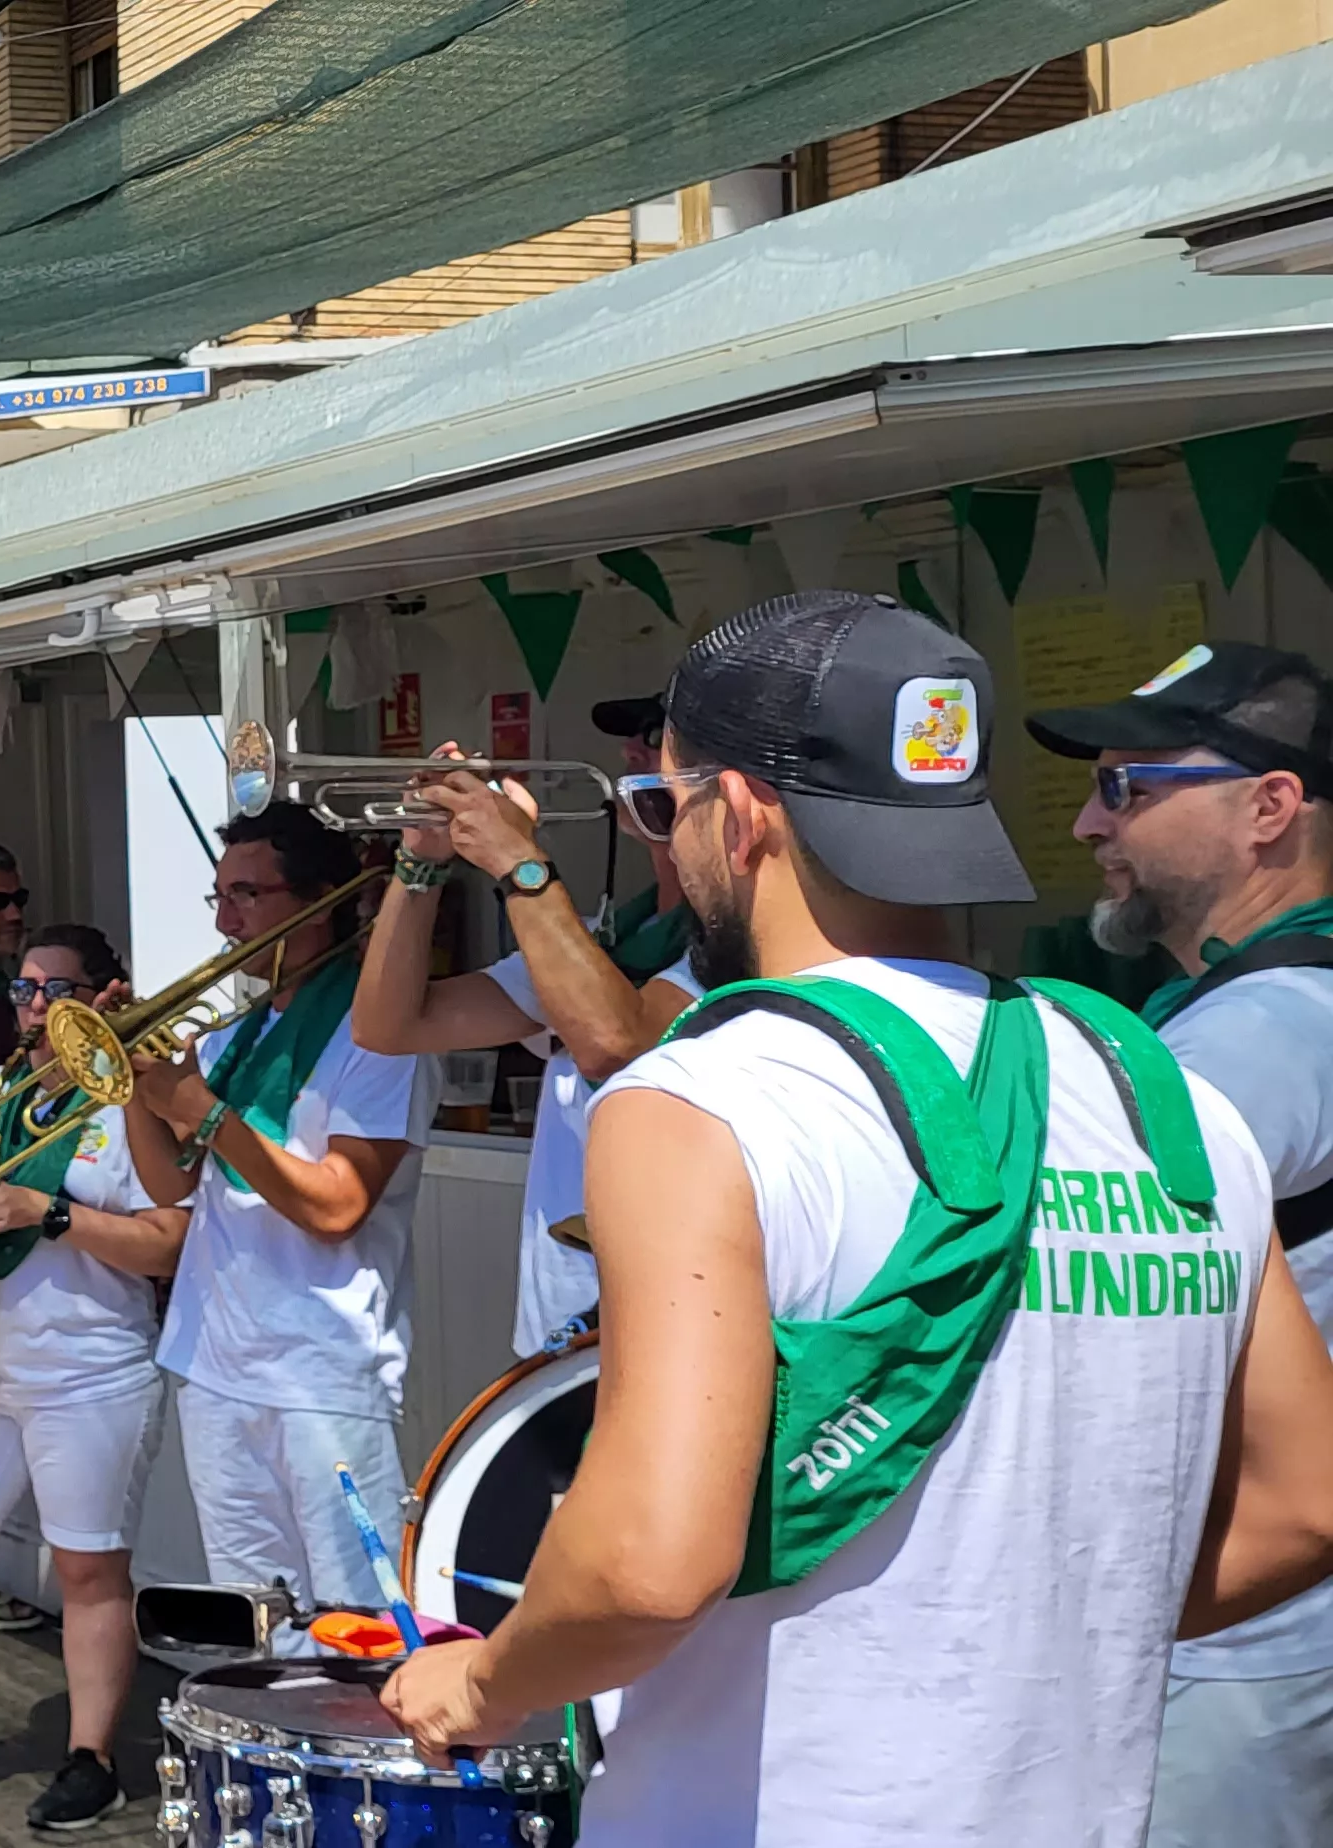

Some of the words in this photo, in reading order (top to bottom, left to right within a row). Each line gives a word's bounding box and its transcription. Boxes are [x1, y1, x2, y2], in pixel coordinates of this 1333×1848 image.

[12, 391, 45, 407] +34
[52, 387, 85, 403] 974
[93, 382, 126, 399] 238
[134, 376, 167, 394] 238
